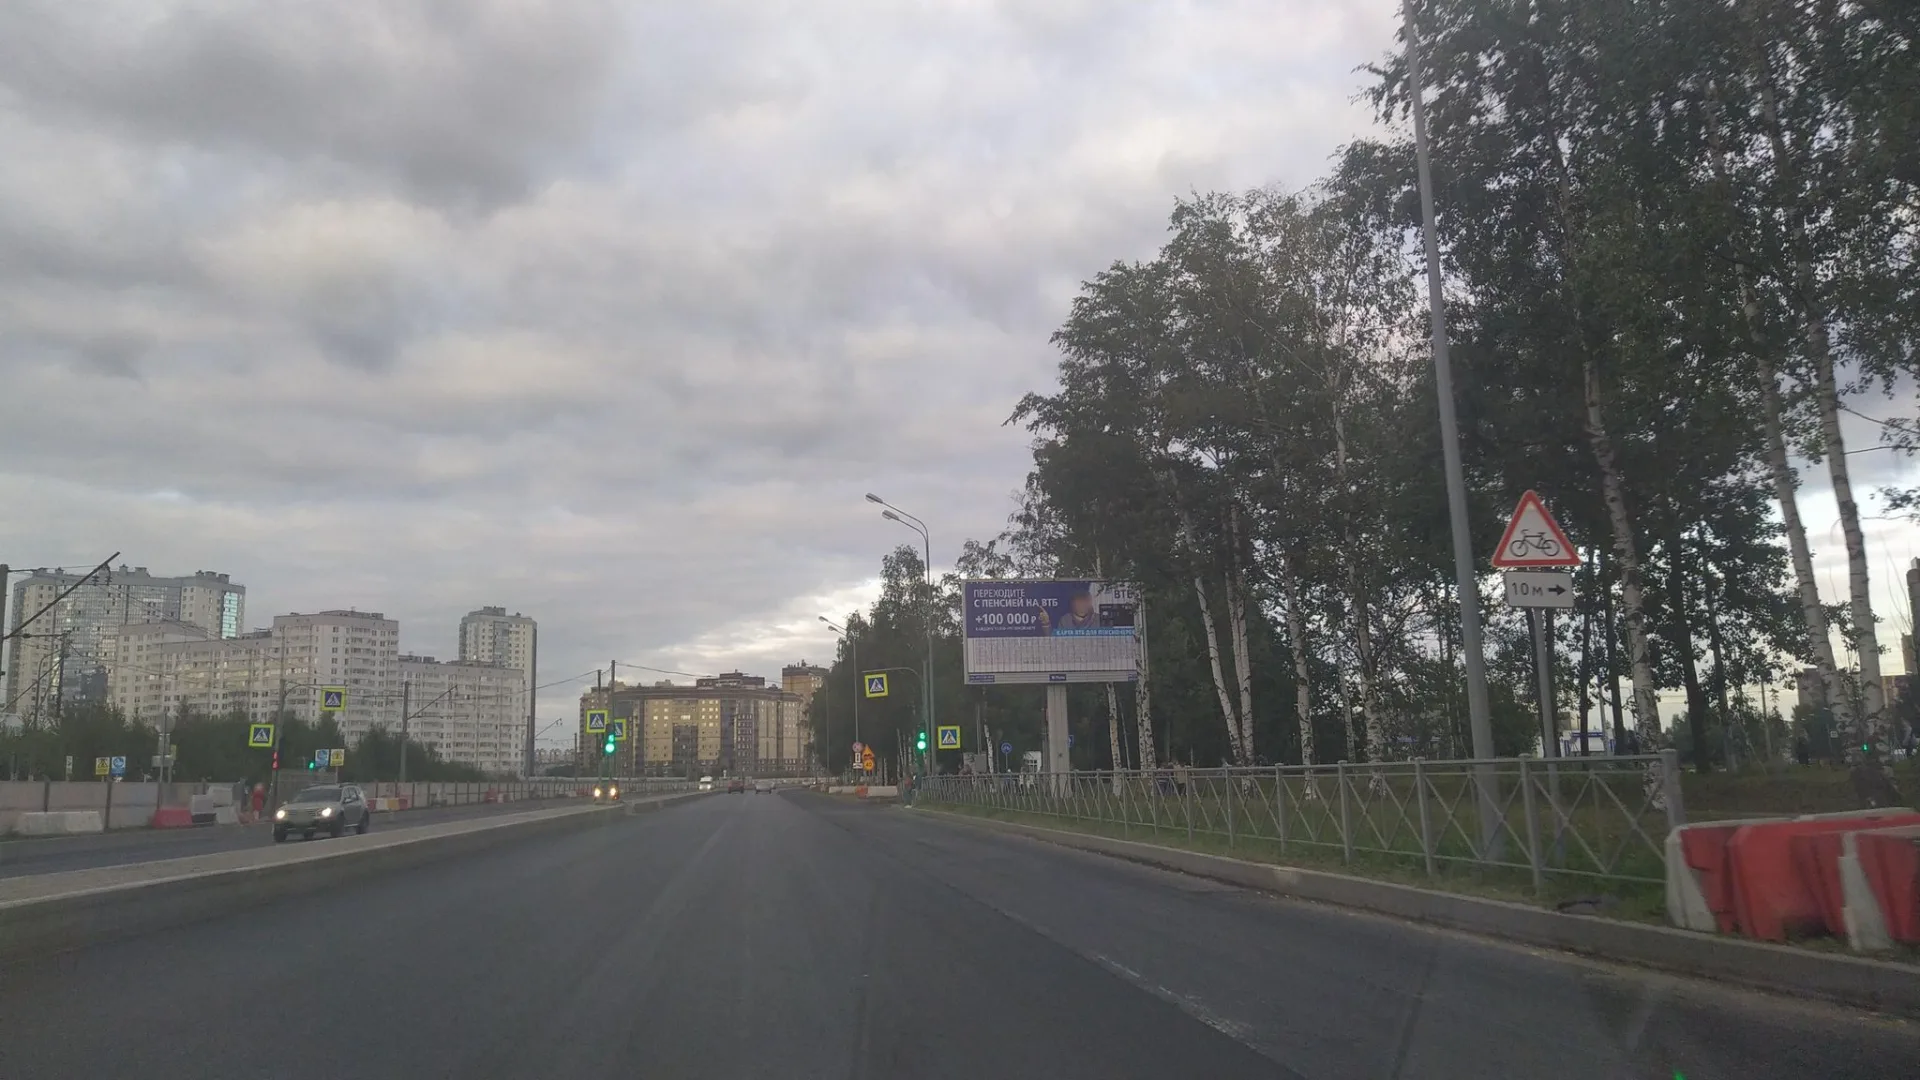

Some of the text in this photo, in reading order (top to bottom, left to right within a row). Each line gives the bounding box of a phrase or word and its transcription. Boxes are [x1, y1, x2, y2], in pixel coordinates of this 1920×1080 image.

[973, 588, 1025, 598] ПЕРЕХОДИТЕ
[974, 597, 1058, 608] С ПЕНСИЕЙ НА ВТБ
[975, 613, 1003, 625] +100
[1006, 613, 1029, 625] 000
